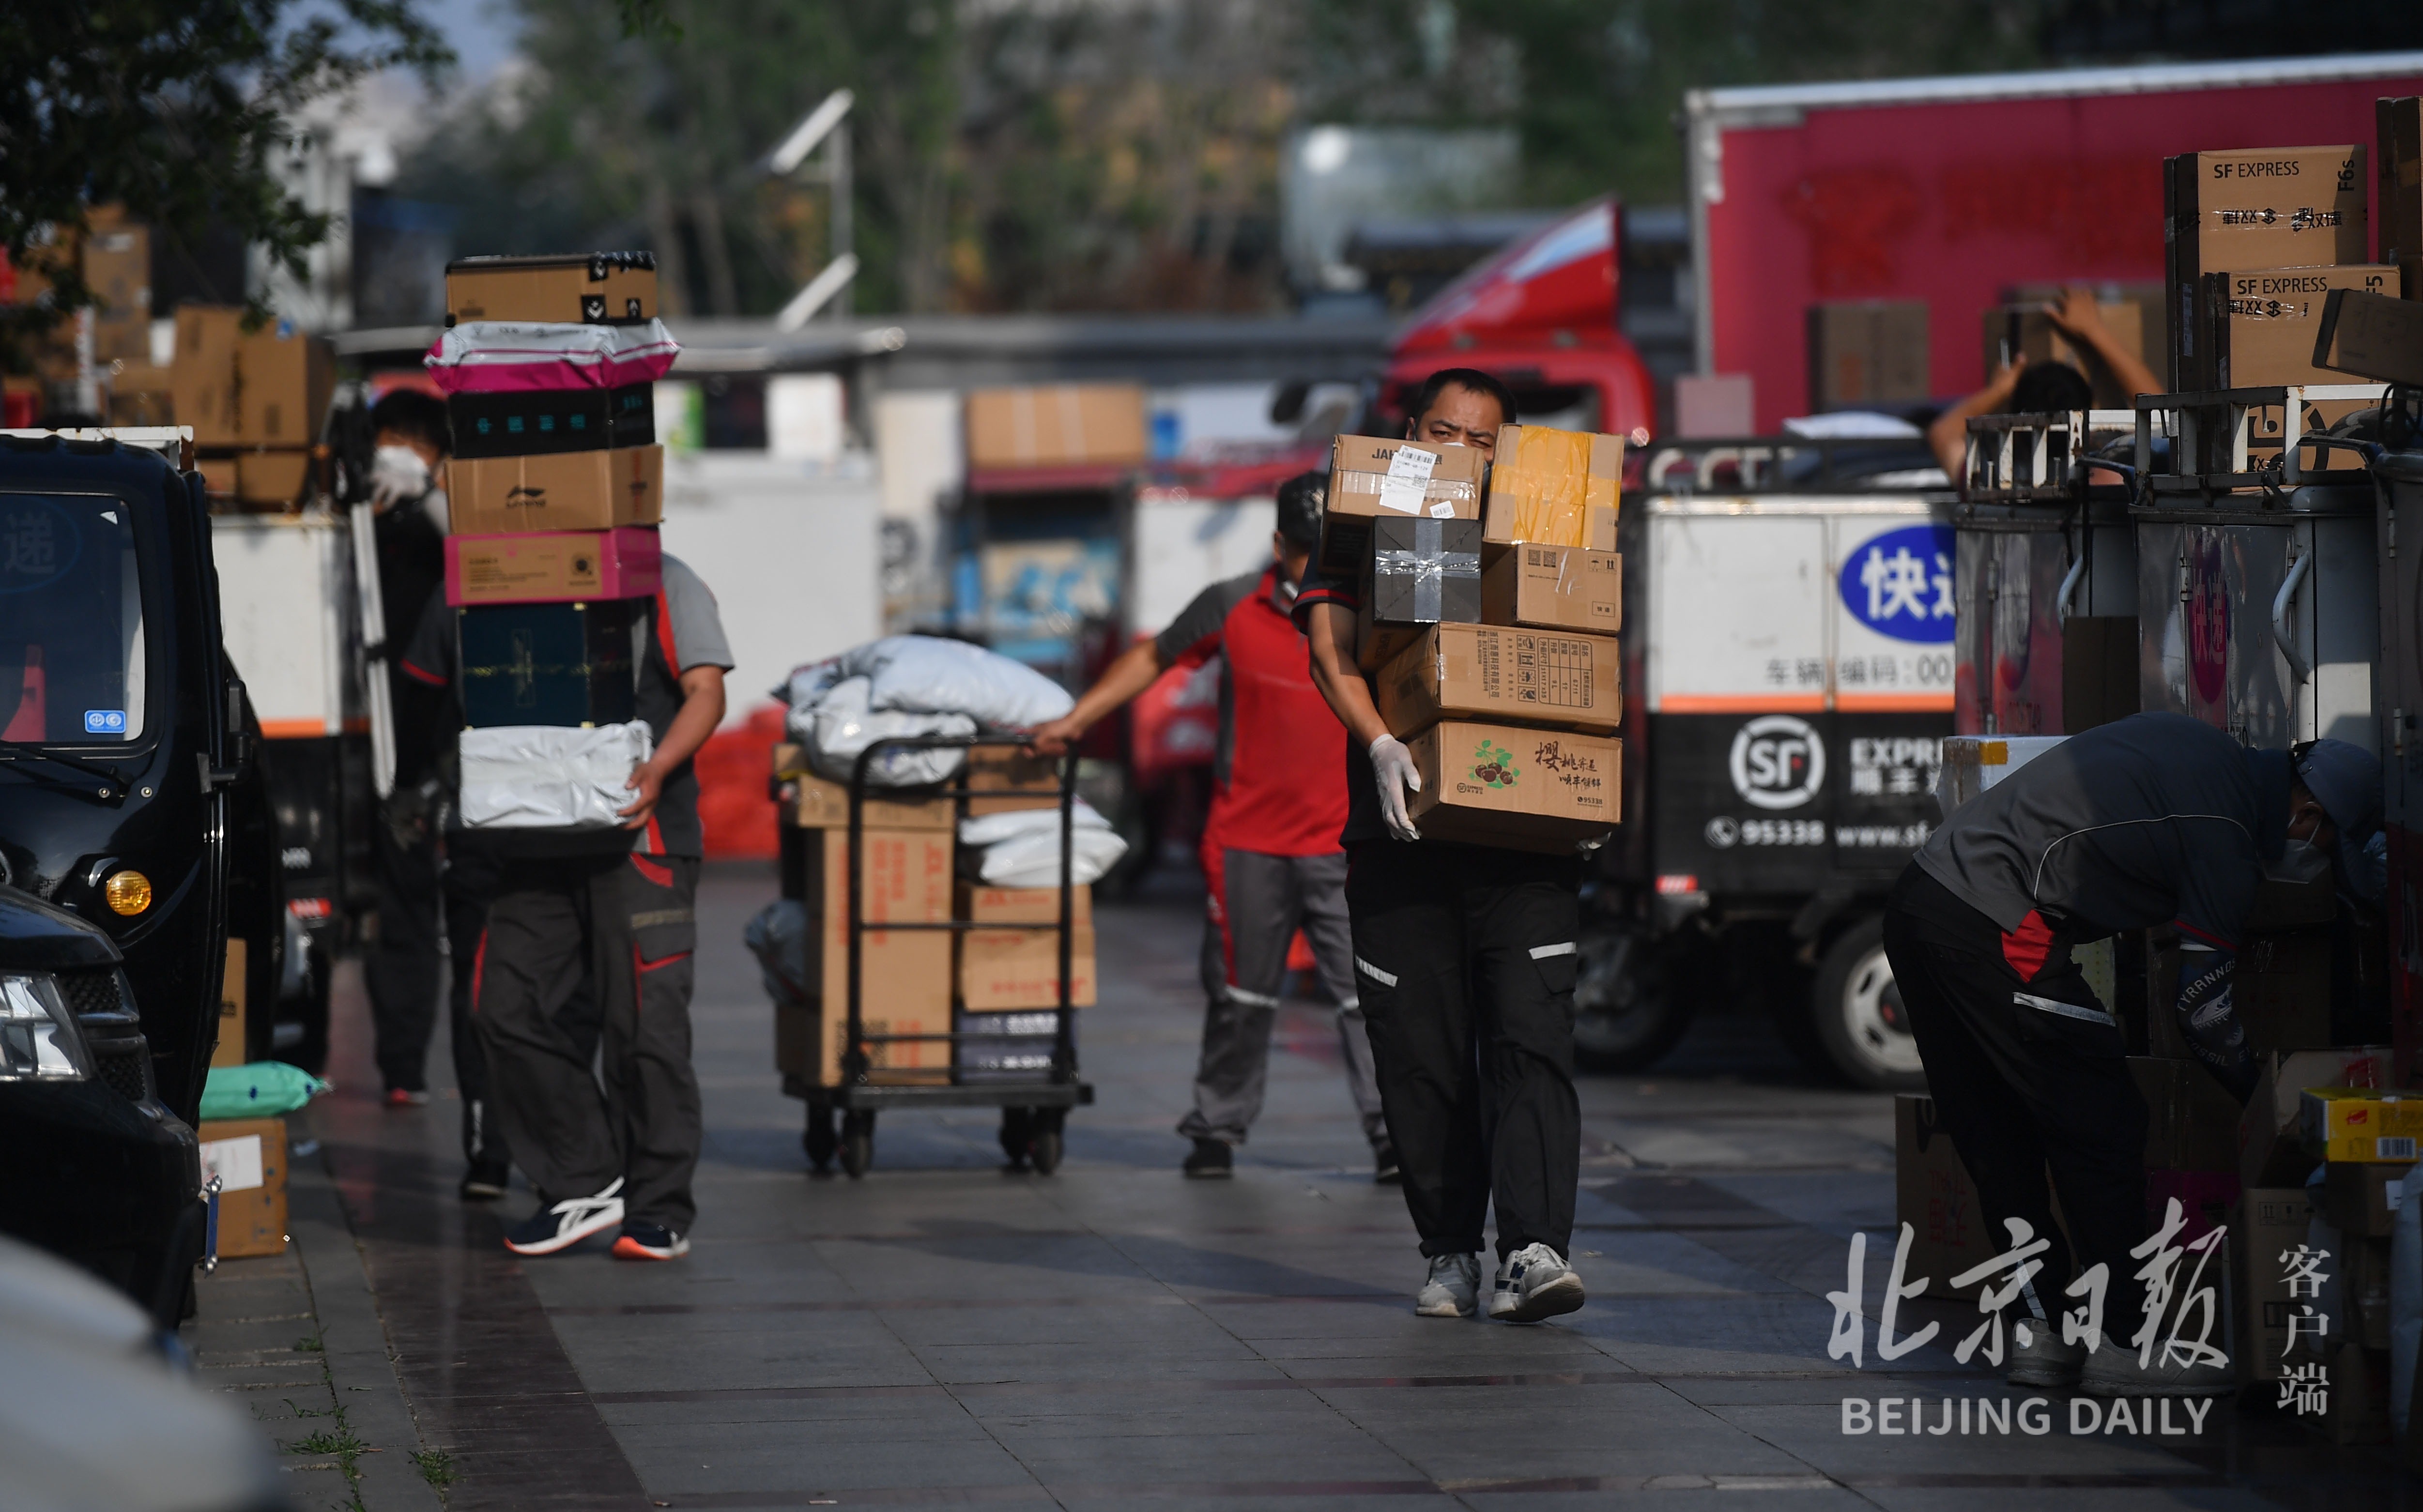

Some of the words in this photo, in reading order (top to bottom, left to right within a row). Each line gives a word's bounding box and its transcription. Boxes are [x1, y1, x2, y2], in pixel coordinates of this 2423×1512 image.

[2213, 164, 2233, 179] SF
[2238, 161, 2300, 178] EXPRESS
[2338, 160, 2355, 191] F6s
[2223, 209, 2257, 225] 双捷
[2237, 279, 2257, 294] SF
[2262, 277, 2328, 293] EXPRESS
[2366, 275, 2383, 295] F5
[3, 510, 56, 574] 递
[1581, 644, 1589, 657] 品名
[1850, 737, 1943, 766] EXPR
[1583, 796, 1603, 805] 95338
[1739, 819, 1826, 846] 95338
